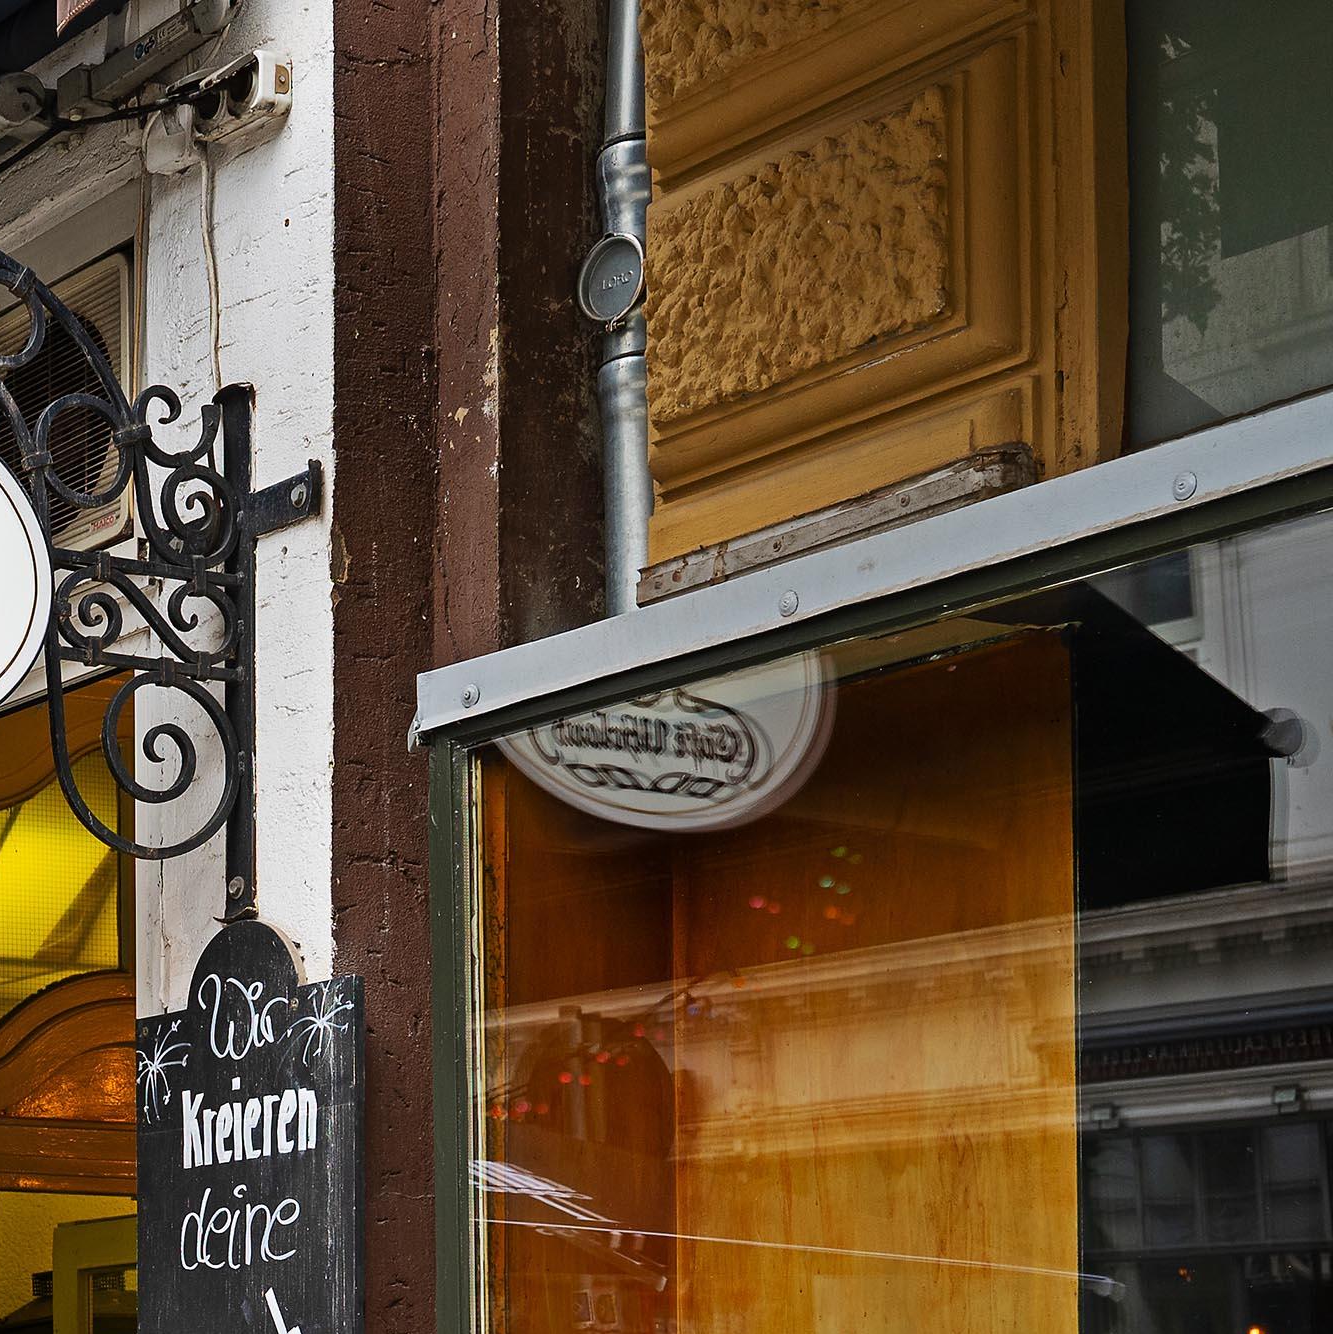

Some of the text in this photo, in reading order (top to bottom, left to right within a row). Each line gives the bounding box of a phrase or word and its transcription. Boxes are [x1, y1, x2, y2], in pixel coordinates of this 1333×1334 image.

[198, 973, 294, 1061] Wir
[181, 1077, 318, 1169] Kreieren
[180, 1184, 301, 1271] deine
